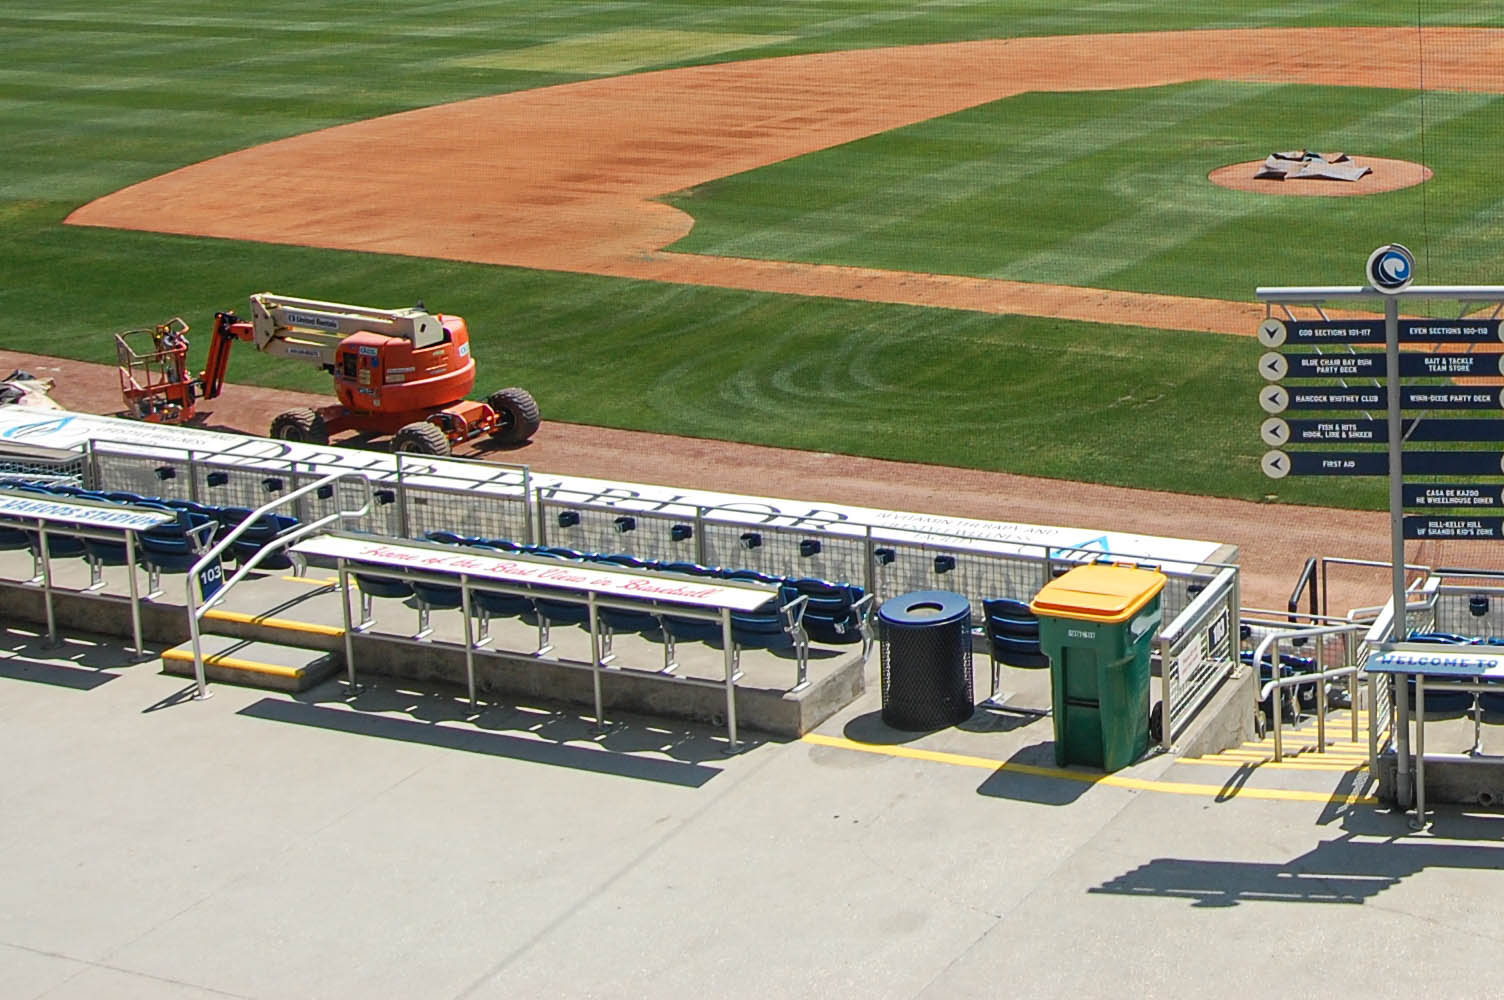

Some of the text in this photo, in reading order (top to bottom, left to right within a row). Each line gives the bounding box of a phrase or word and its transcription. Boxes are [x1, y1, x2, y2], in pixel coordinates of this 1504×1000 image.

[1314, 328, 1347, 336] SECTIONS
[1409, 327, 1427, 335] EVEN
[1428, 327, 1461, 335] SECTIONS
[1424, 357, 1440, 365] BAIT
[1316, 366, 1338, 374] PARTY
[1322, 460, 1356, 468] FIRST AID
[1426, 489, 1444, 497] CASA
[201, 564, 222, 585] 103
[362, 544, 721, 599] Home of the Best View in Baseball
[1379, 652, 1472, 669] WELCOME
[1475, 659, 1499, 669] TO
